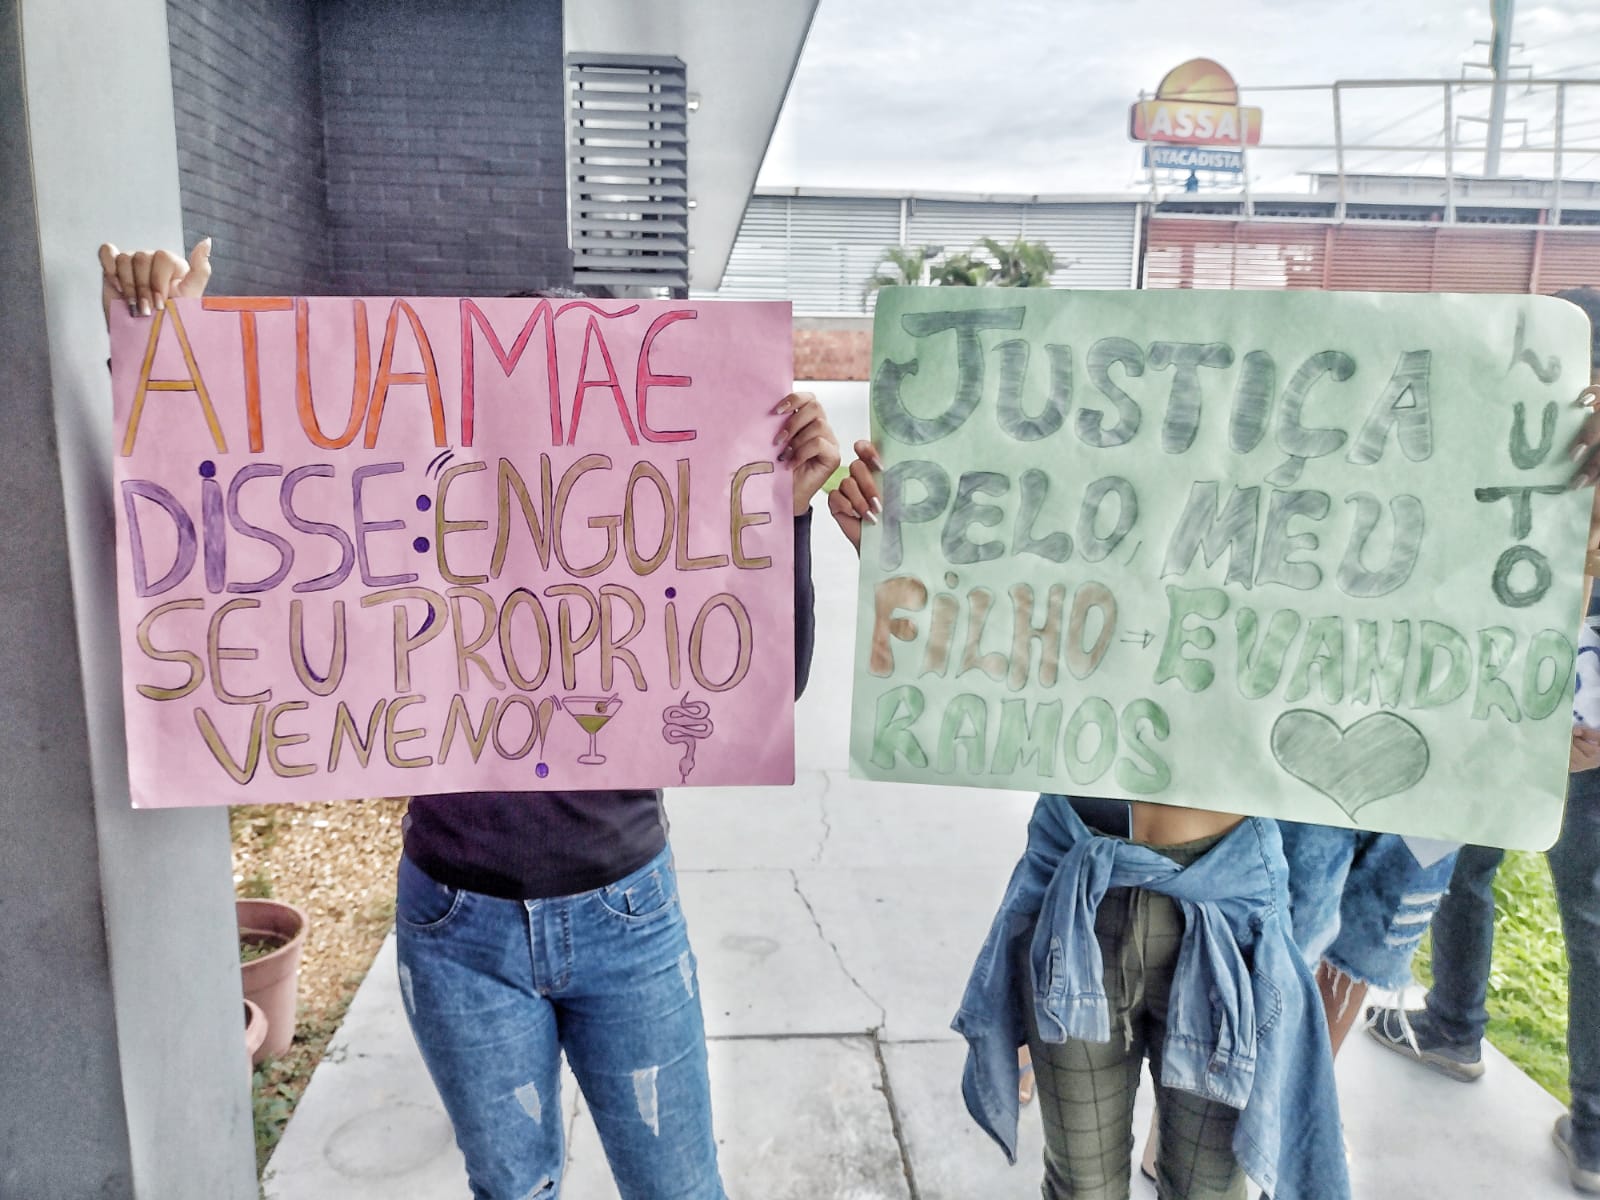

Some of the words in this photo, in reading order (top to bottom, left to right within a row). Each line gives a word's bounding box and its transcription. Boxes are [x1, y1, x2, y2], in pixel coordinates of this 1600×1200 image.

[121, 297, 228, 457] A
[202, 296, 447, 453] TUA
[459, 297, 698, 448] MÃE
[872, 305, 1434, 488] JUSTIÇA
[1160, 480, 1425, 599] MEU
[136, 597, 348, 705] SEU
[1153, 585, 1575, 723] EVANDRO
[869, 684, 1172, 795] RAMOS
